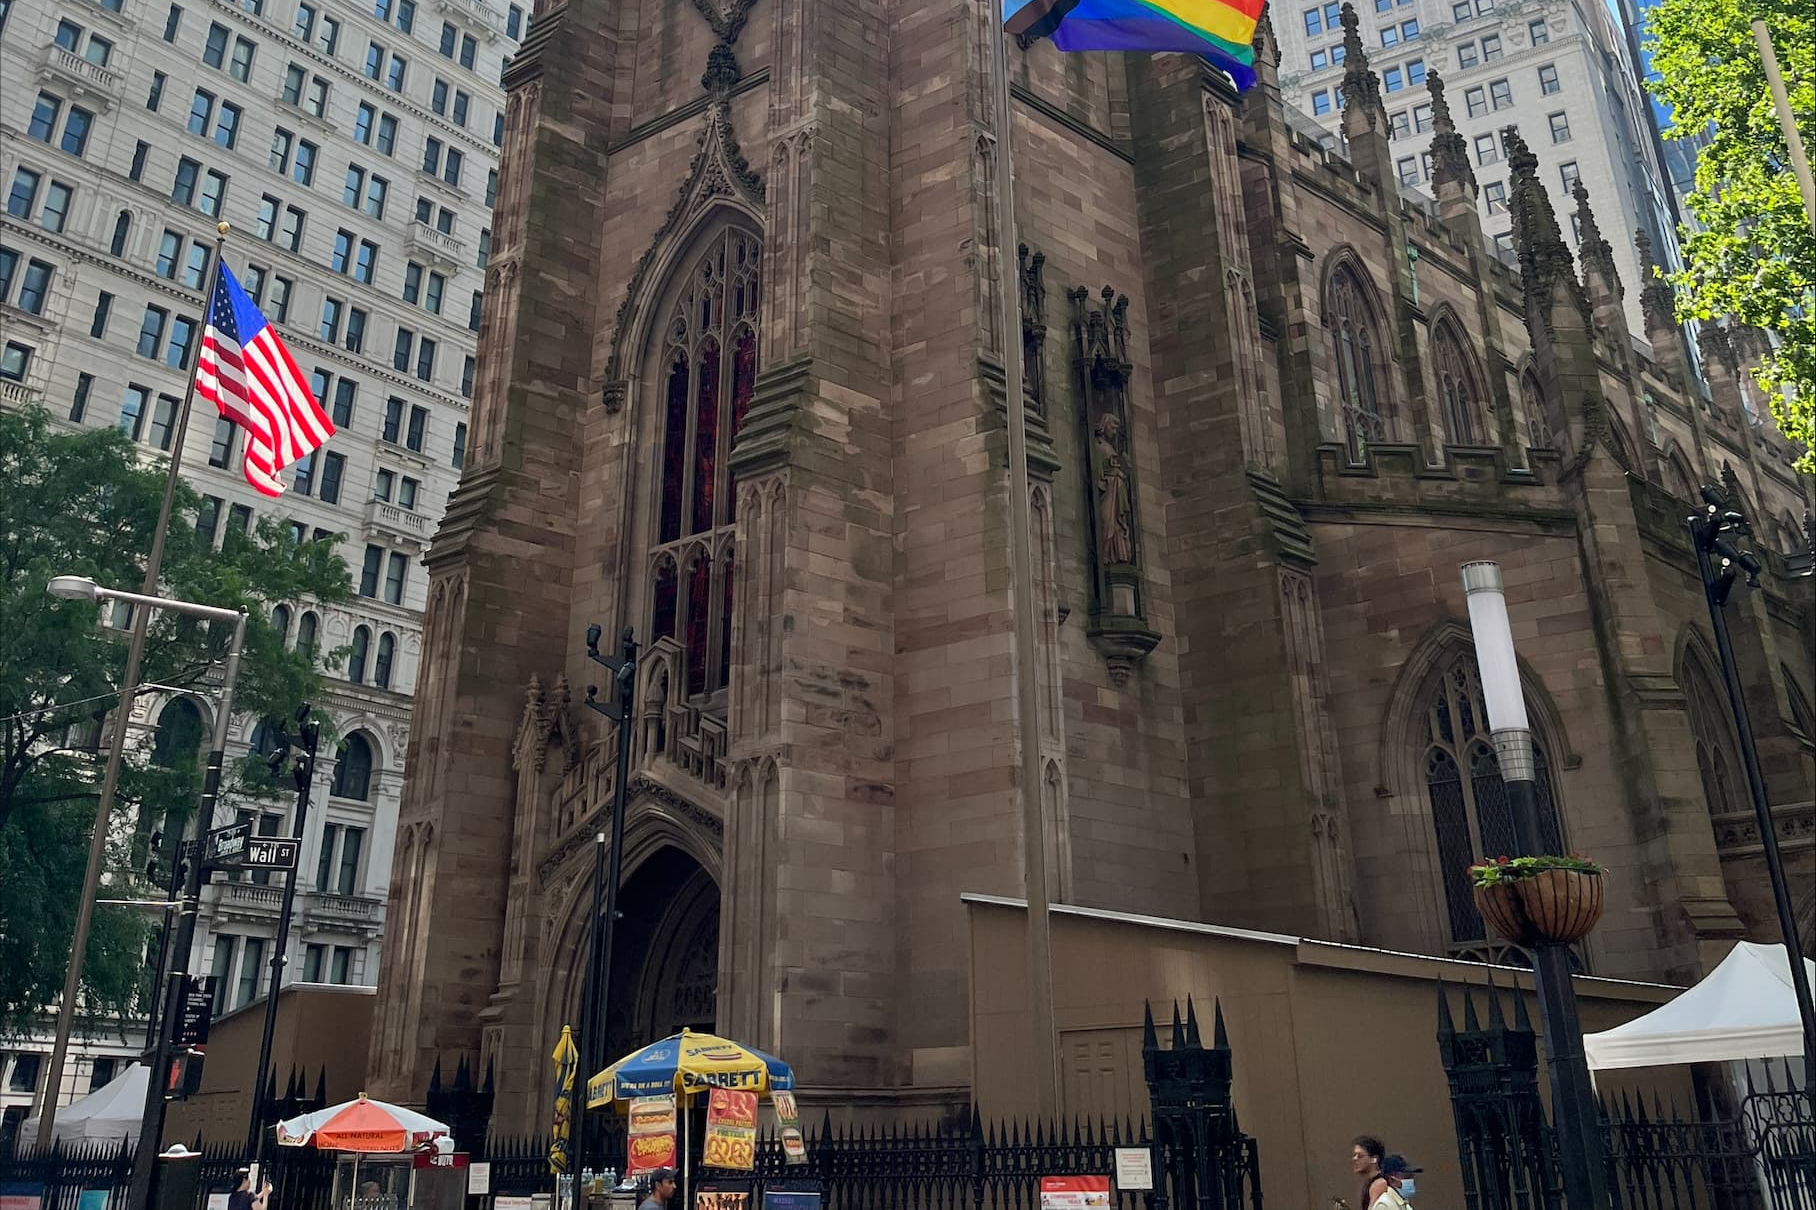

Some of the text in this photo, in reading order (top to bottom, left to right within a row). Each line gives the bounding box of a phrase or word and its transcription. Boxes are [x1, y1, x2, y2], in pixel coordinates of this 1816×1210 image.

[218, 836, 245, 852] Broadway
[250, 846, 276, 863] Wall
[281, 848, 290, 857] ST
[686, 1045, 733, 1057] SABRETT
[683, 1070, 761, 1088] SABRETT
[350, 1131, 384, 1139] NATURAL
